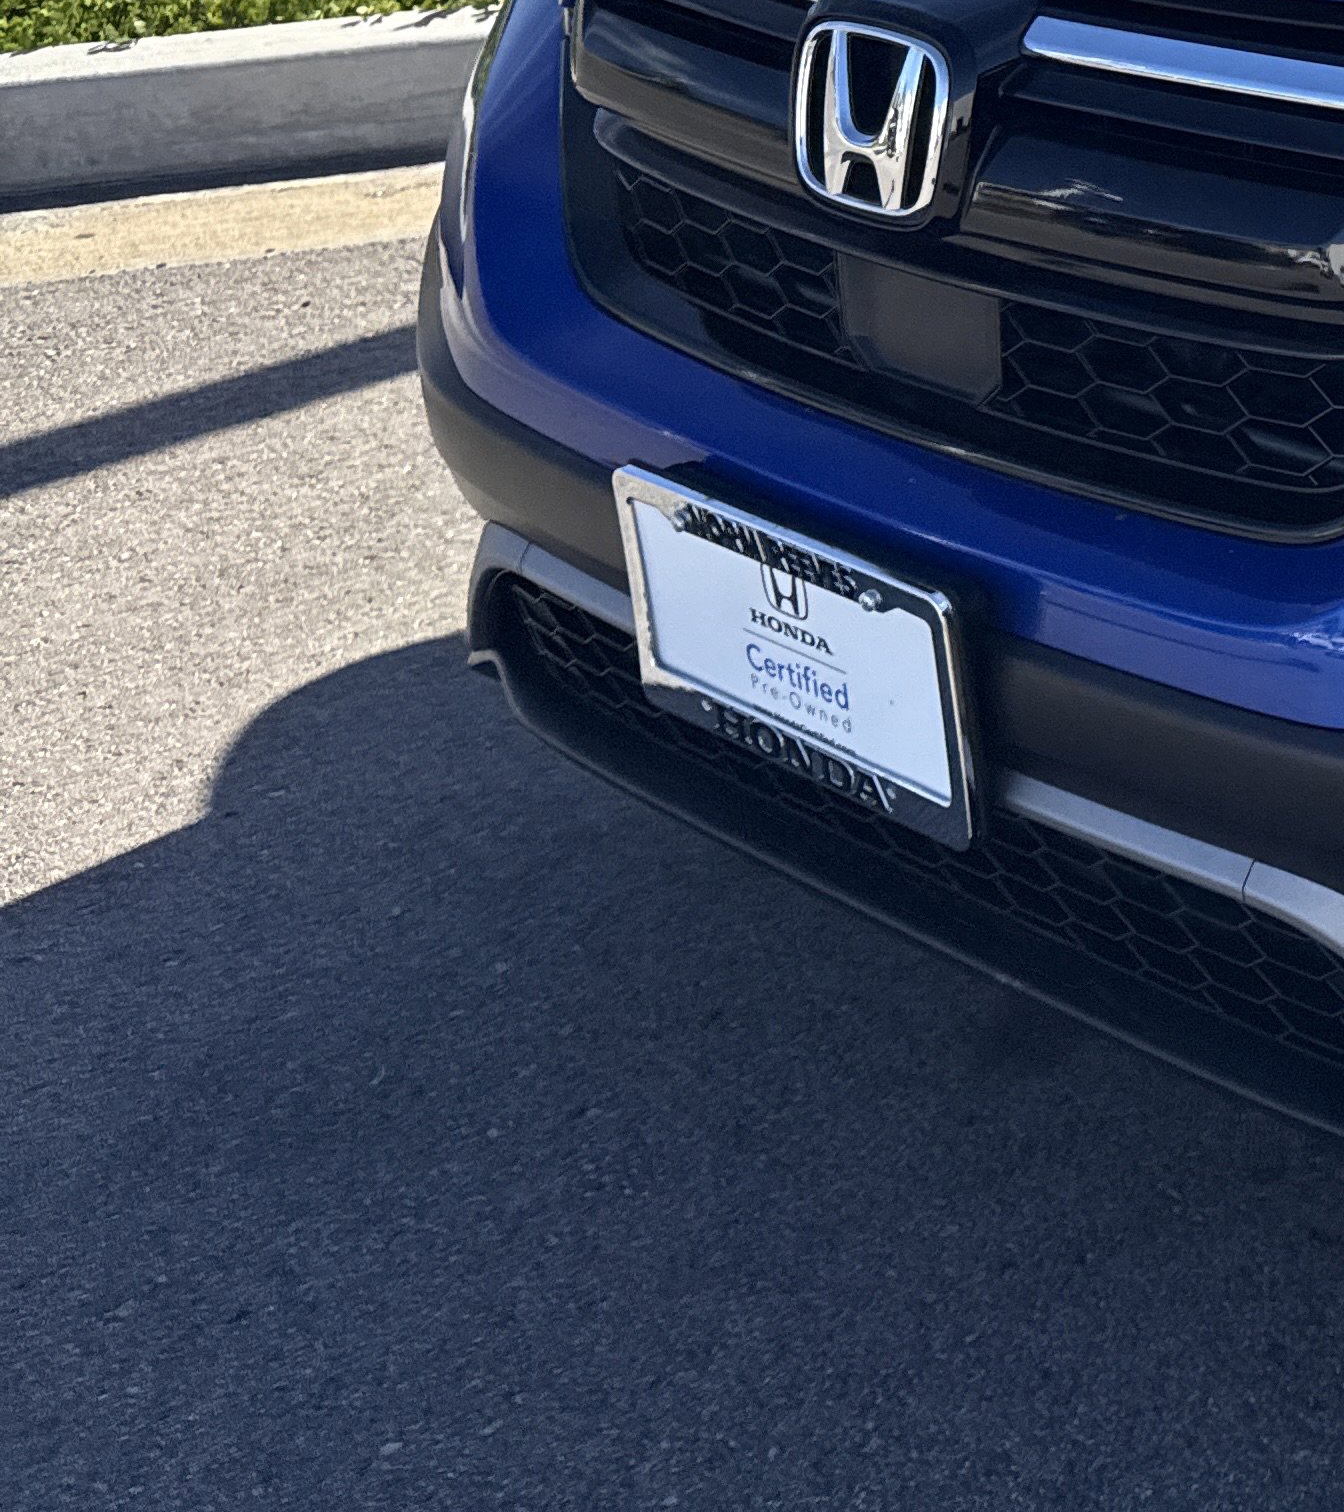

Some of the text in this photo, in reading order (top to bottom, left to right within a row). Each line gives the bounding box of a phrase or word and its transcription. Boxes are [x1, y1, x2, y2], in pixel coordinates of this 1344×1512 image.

[748, 607, 835, 656] HONDA
[746, 643, 850, 712] Certified
[750, 672, 852, 734] Pre-Owned
[710, 704, 895, 813] HONDA
